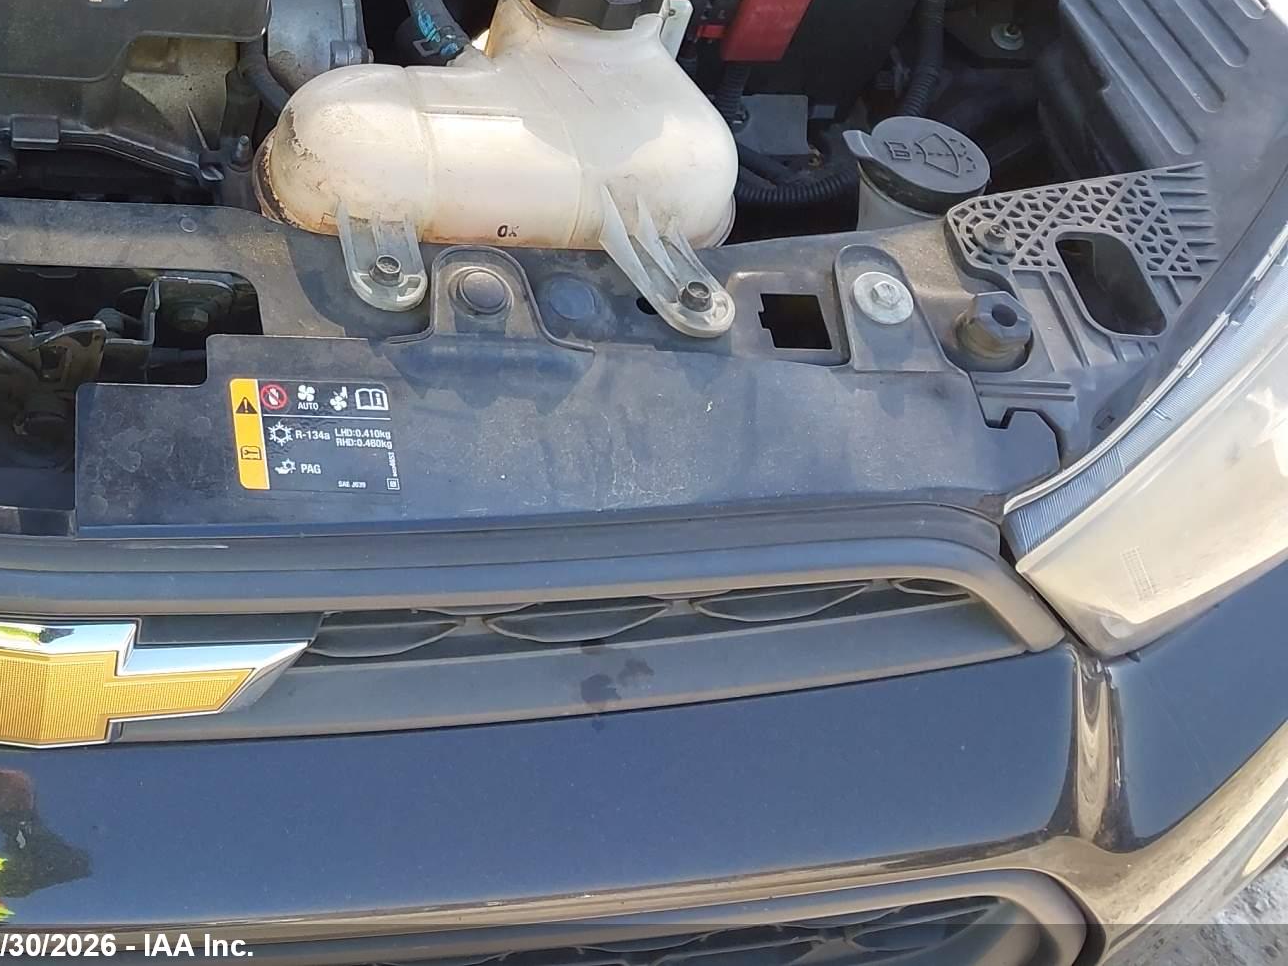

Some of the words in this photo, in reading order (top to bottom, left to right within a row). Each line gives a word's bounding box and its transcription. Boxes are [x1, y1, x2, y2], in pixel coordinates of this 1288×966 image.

[297, 402, 319, 411] AUTO
[295, 430, 330, 440] R-134a
[334, 428, 392, 440] LHD:0.410kg
[300, 463, 322, 475] PAG
